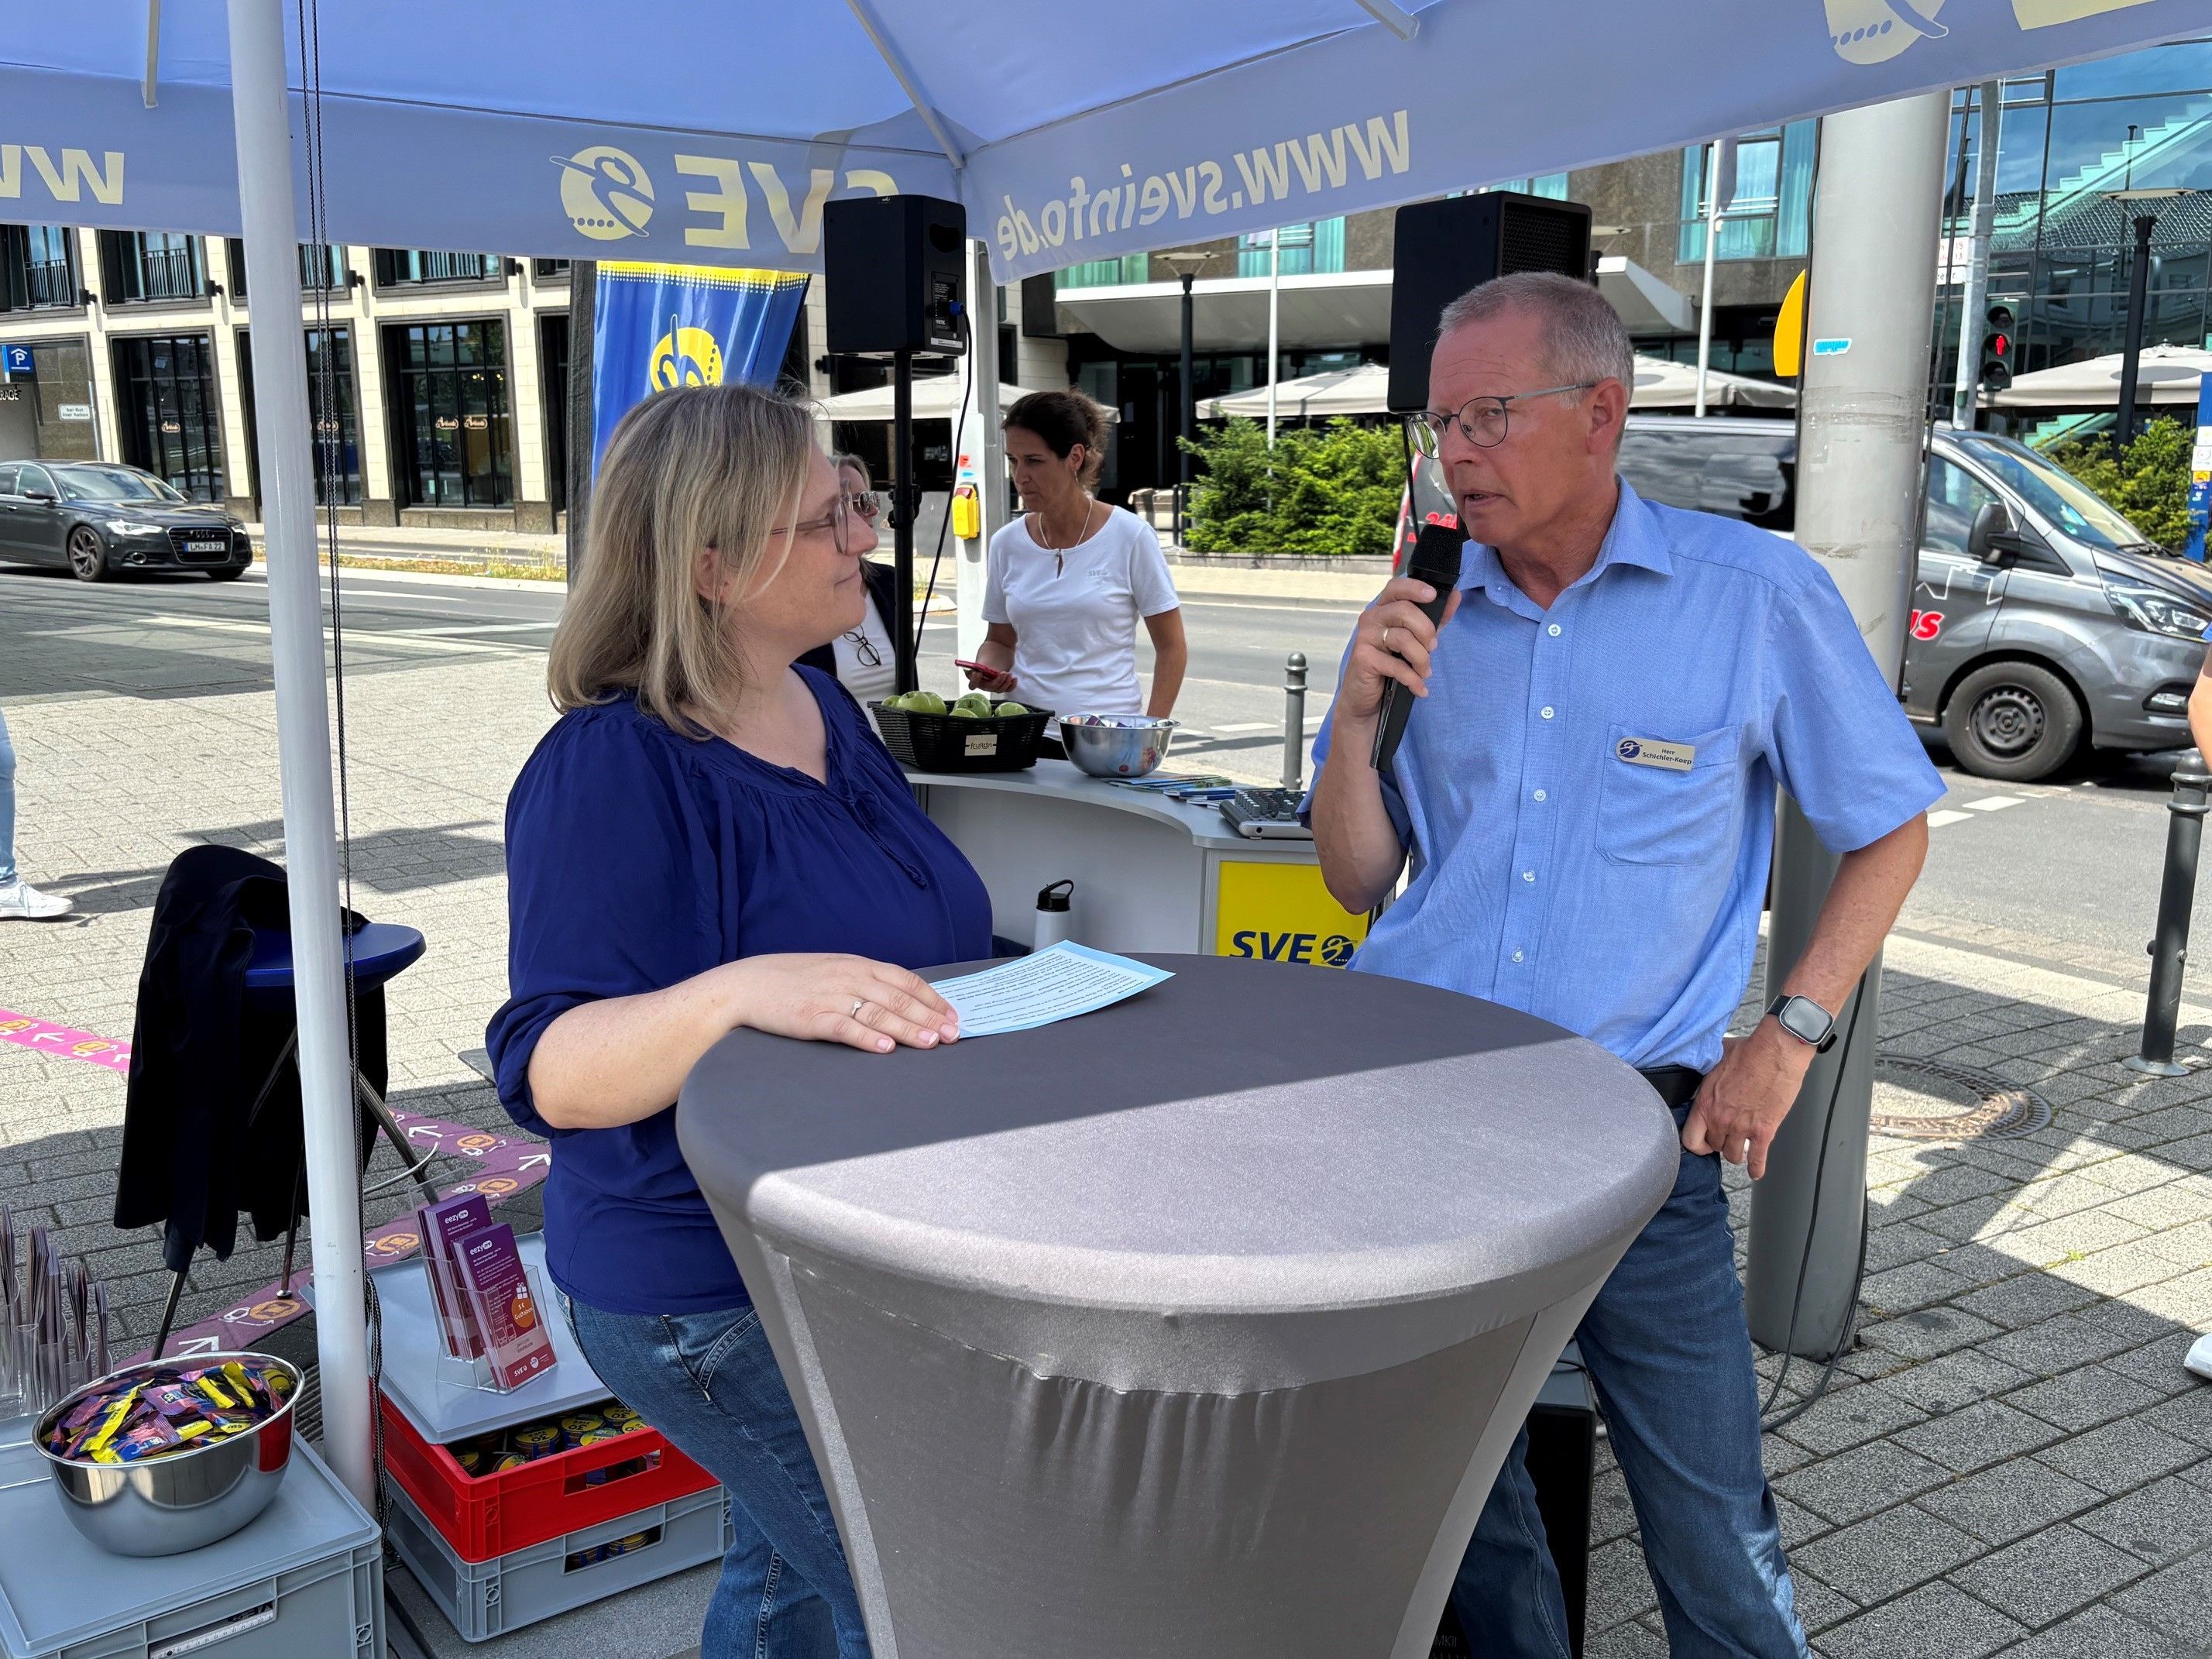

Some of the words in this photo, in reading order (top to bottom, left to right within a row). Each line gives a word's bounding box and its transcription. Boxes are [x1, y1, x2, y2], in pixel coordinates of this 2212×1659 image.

[15, 352, 26, 366] P
[1229, 930, 1317, 964] SVE
[445, 1214, 459, 1224] eezy
[469, 1244, 483, 1255] eezy
[531, 1434, 548, 1442] 30
